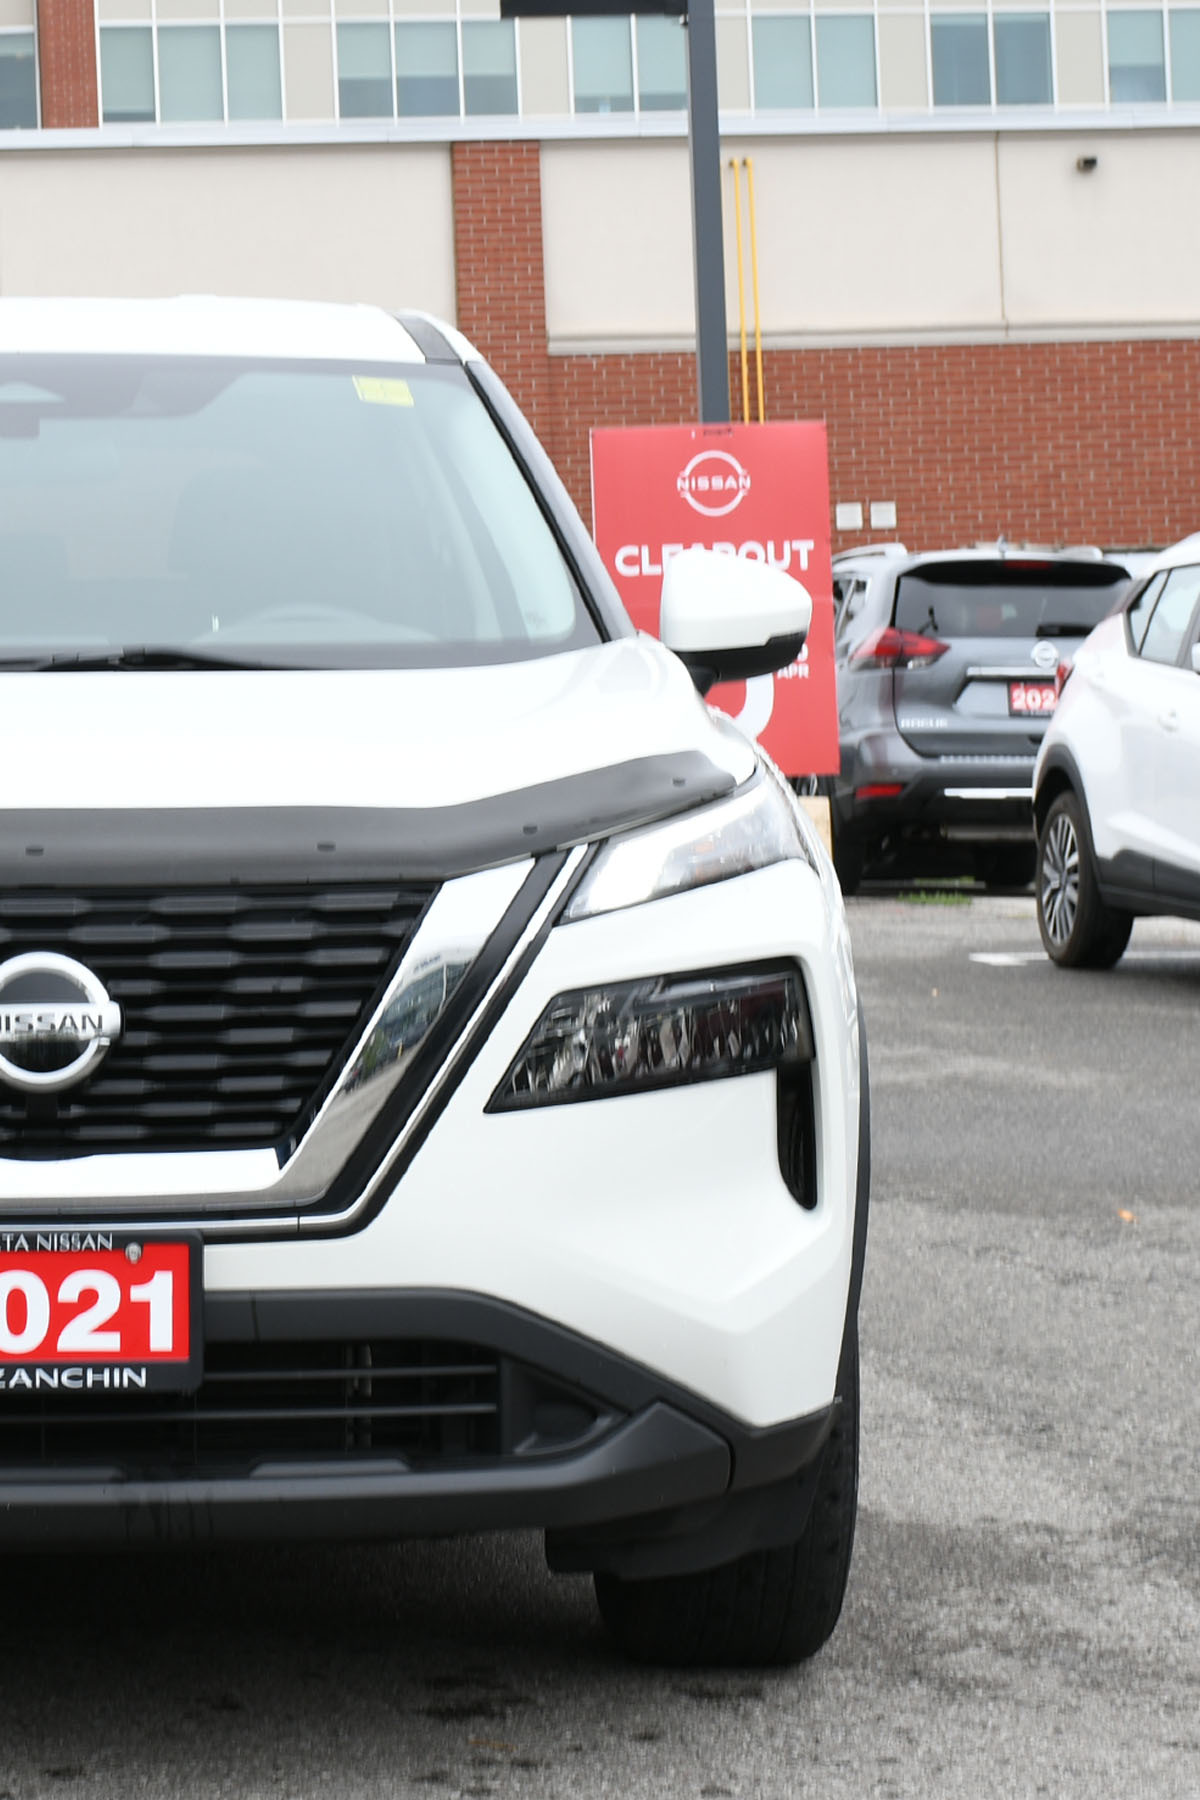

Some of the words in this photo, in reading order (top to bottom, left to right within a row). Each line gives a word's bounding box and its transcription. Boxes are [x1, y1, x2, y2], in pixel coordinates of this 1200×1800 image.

[677, 474, 750, 492] NISSAN
[615, 539, 815, 577] CLOUT
[1012, 684, 1057, 712] 202
[36, 1232, 113, 1252] NISSAN
